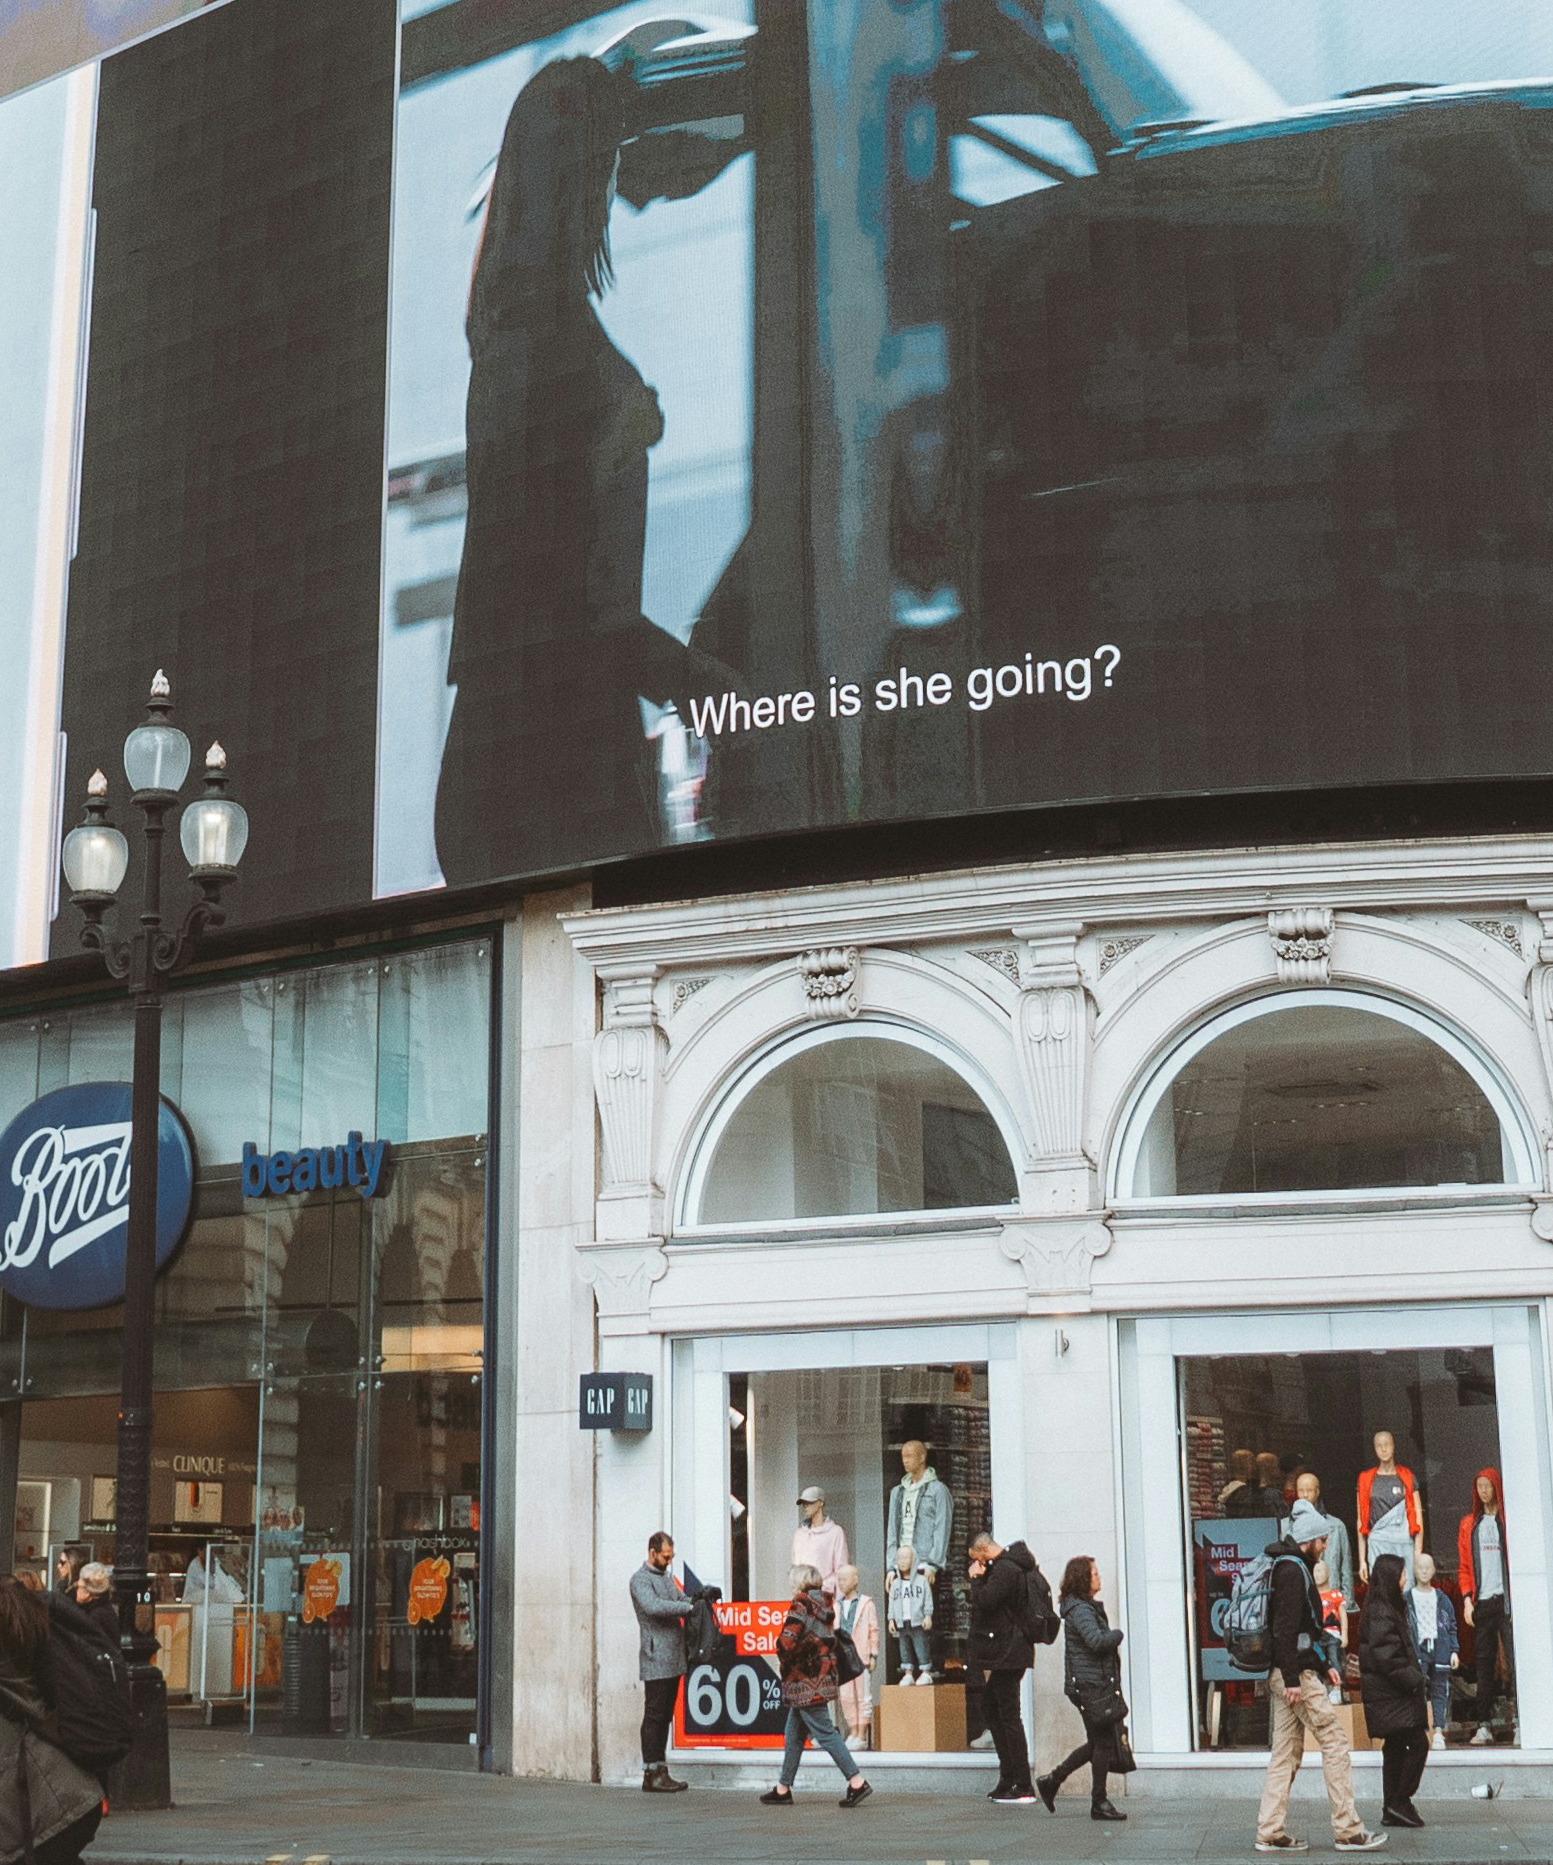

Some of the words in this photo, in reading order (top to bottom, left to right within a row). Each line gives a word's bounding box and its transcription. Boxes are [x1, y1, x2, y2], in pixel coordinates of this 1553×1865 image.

[690, 691, 815, 737] Where
[829, 677, 861, 717] is
[875, 667, 952, 711] she
[967, 644, 1121, 711] going?
[241, 1131, 391, 1200] beauty
[587, 1387, 615, 1415] GAP
[627, 1387, 649, 1414] GAP
[173, 1454, 227, 1477] CLINIQUE
[1210, 1546, 1235, 1559] Mid
[716, 1606, 752, 1627] Mid
[762, 1699, 781, 1710] OFF
